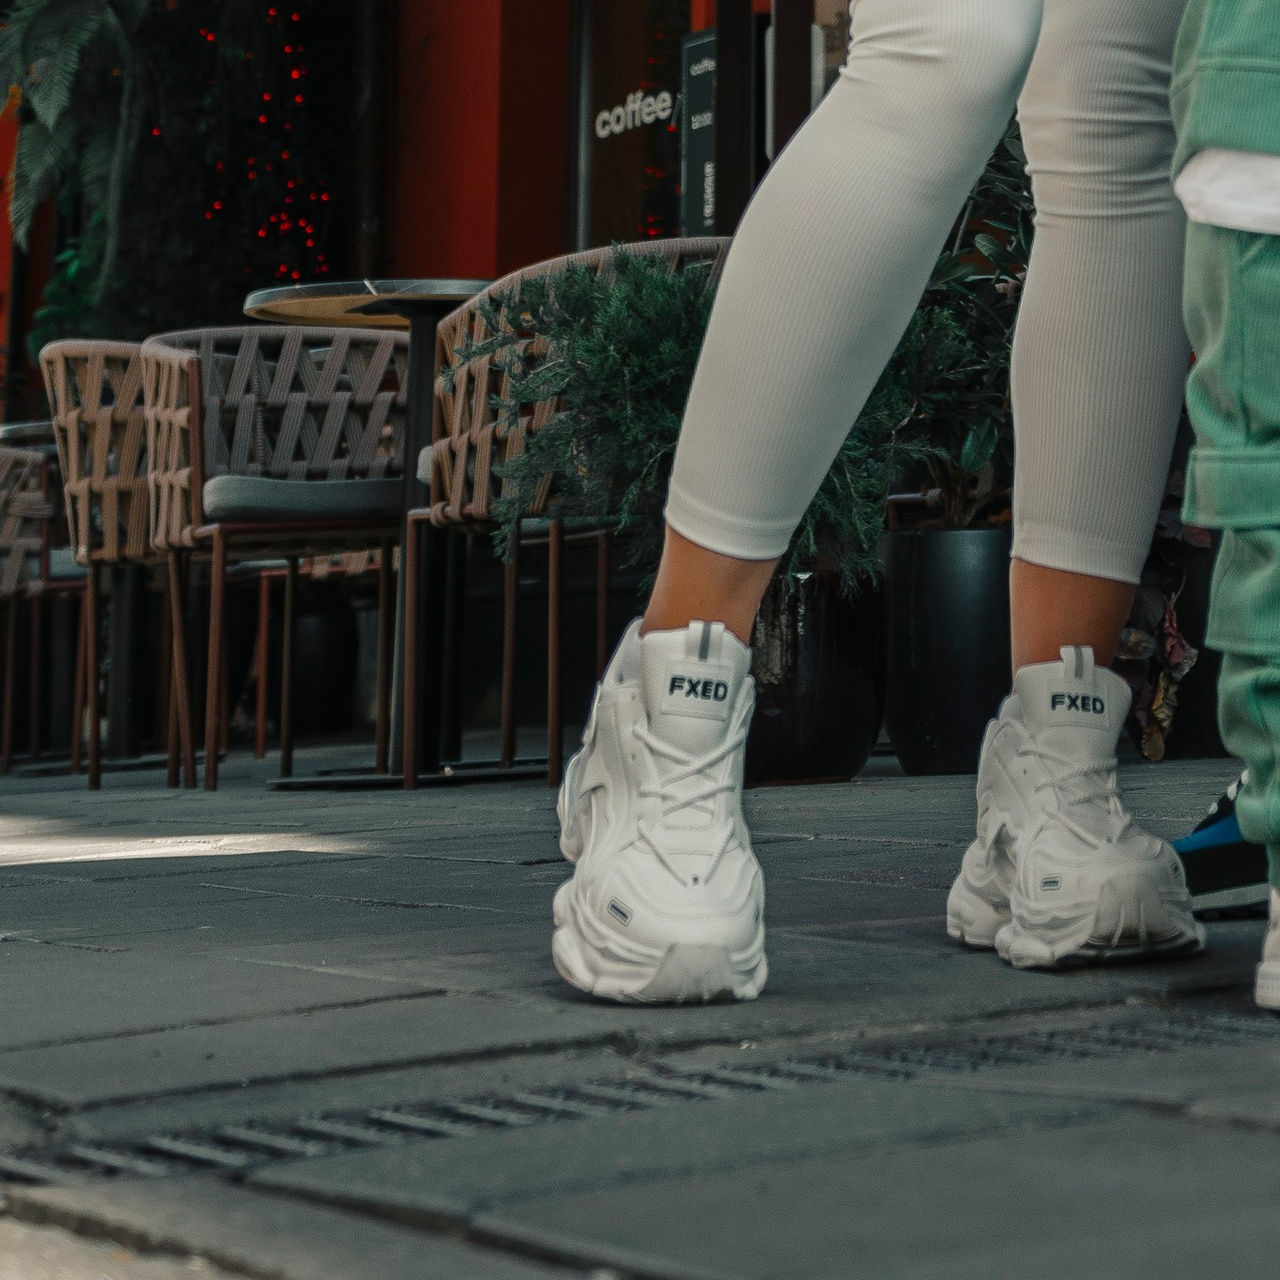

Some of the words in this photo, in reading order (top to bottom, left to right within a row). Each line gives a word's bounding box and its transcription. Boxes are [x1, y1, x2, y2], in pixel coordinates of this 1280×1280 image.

[595, 89, 673, 139] coffee
[668, 675, 728, 702] FXED
[1050, 692, 1105, 715] FXED
